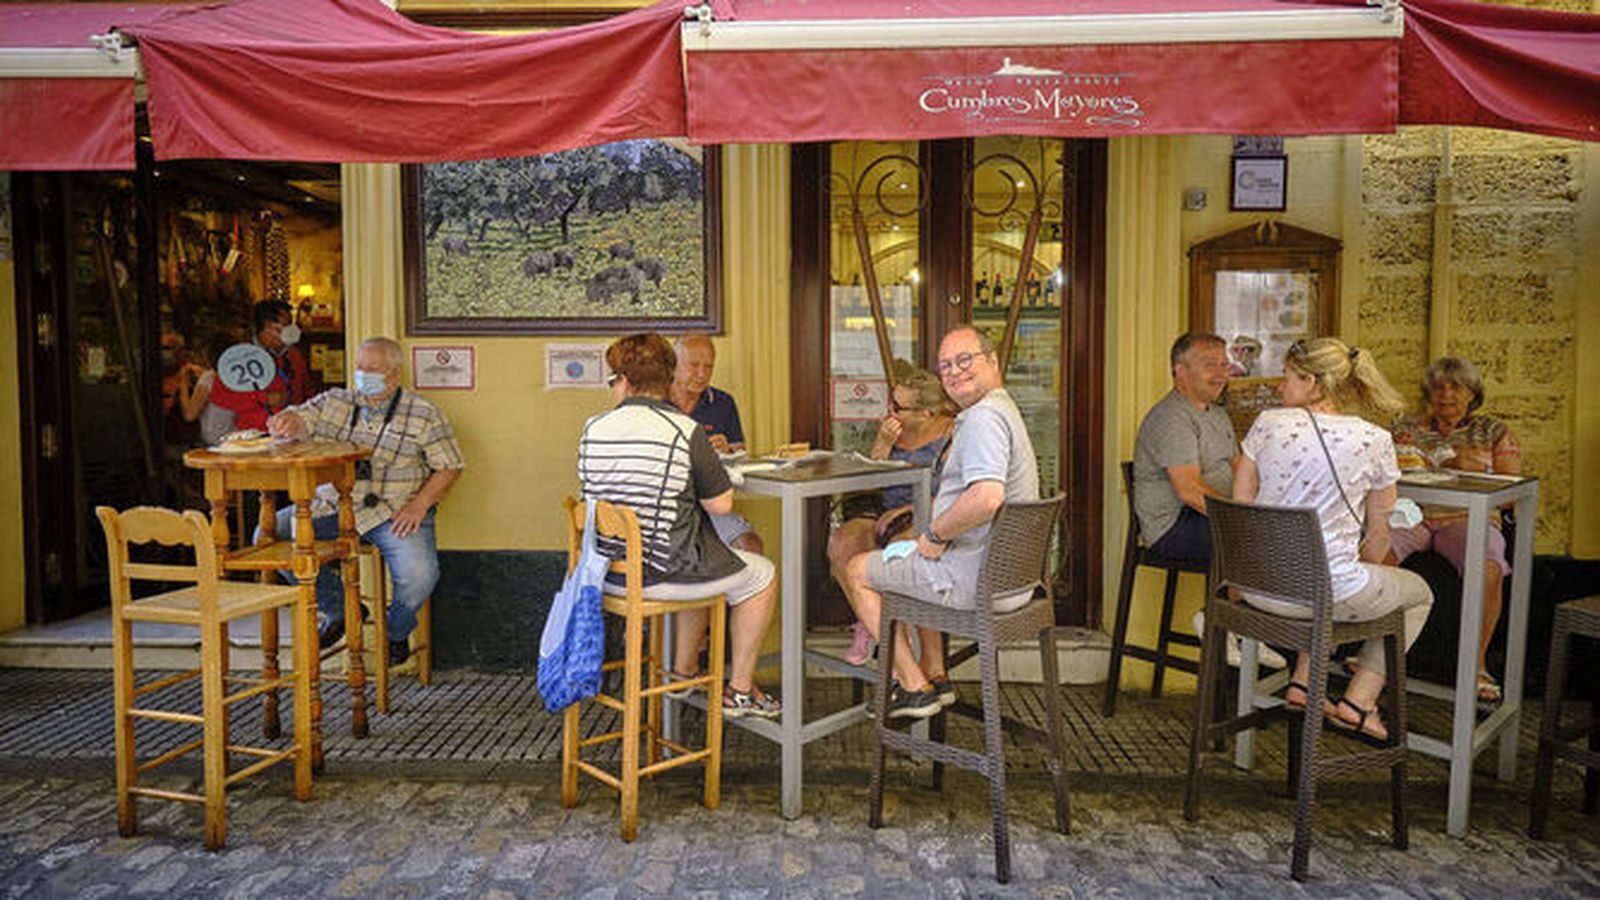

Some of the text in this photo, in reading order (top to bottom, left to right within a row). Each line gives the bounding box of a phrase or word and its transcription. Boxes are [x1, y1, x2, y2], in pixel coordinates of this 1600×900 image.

[919, 88, 1144, 125] Cumbres Mayores
[231, 359, 264, 384] 20
